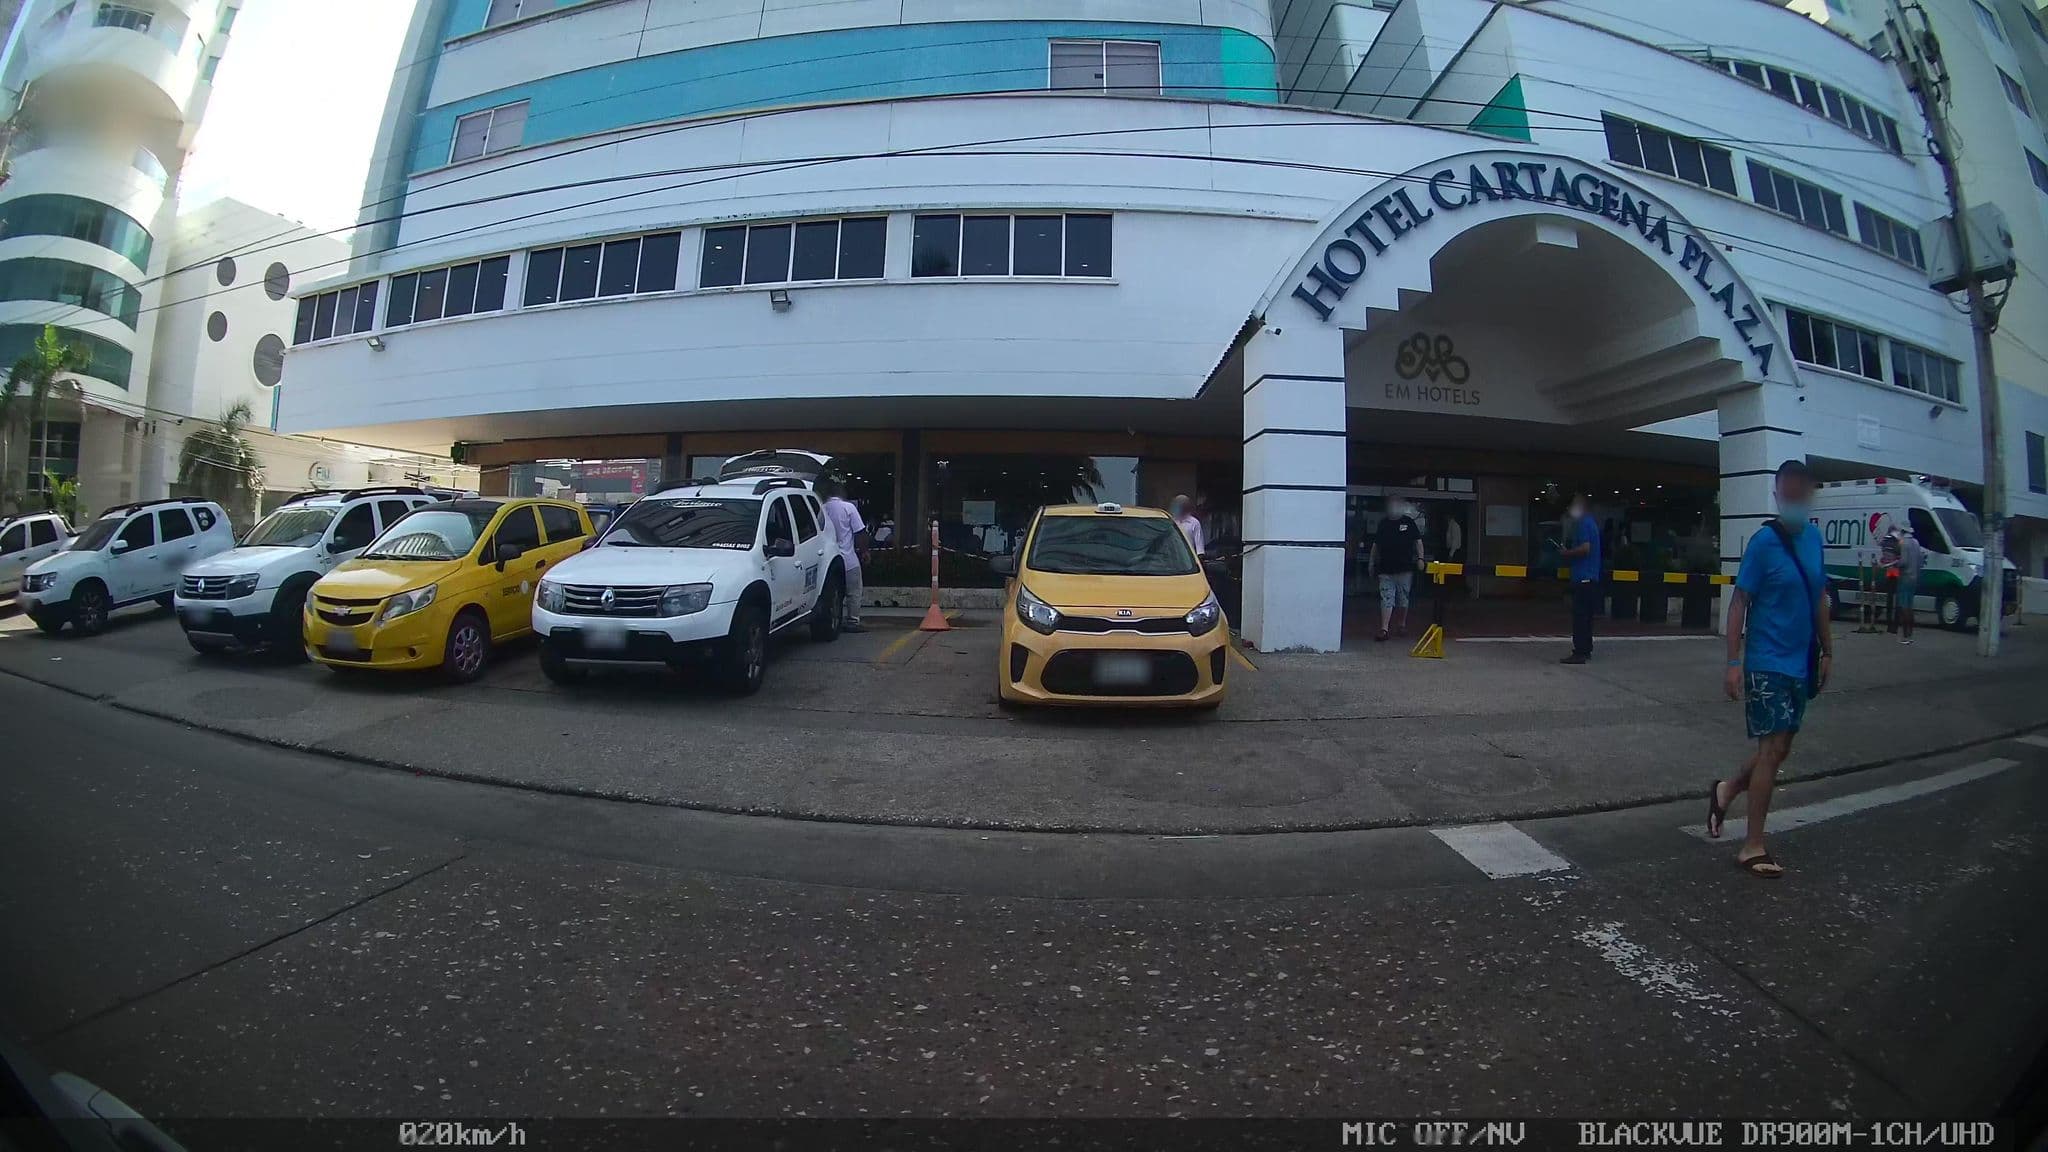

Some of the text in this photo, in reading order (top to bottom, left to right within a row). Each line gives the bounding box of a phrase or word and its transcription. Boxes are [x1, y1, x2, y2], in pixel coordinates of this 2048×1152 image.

[1290, 160, 1775, 378] HOTEL CARTAGENA PLAZA
[1384, 383, 1481, 405] EM HOTELS
[1825, 513, 1868, 546] ami
